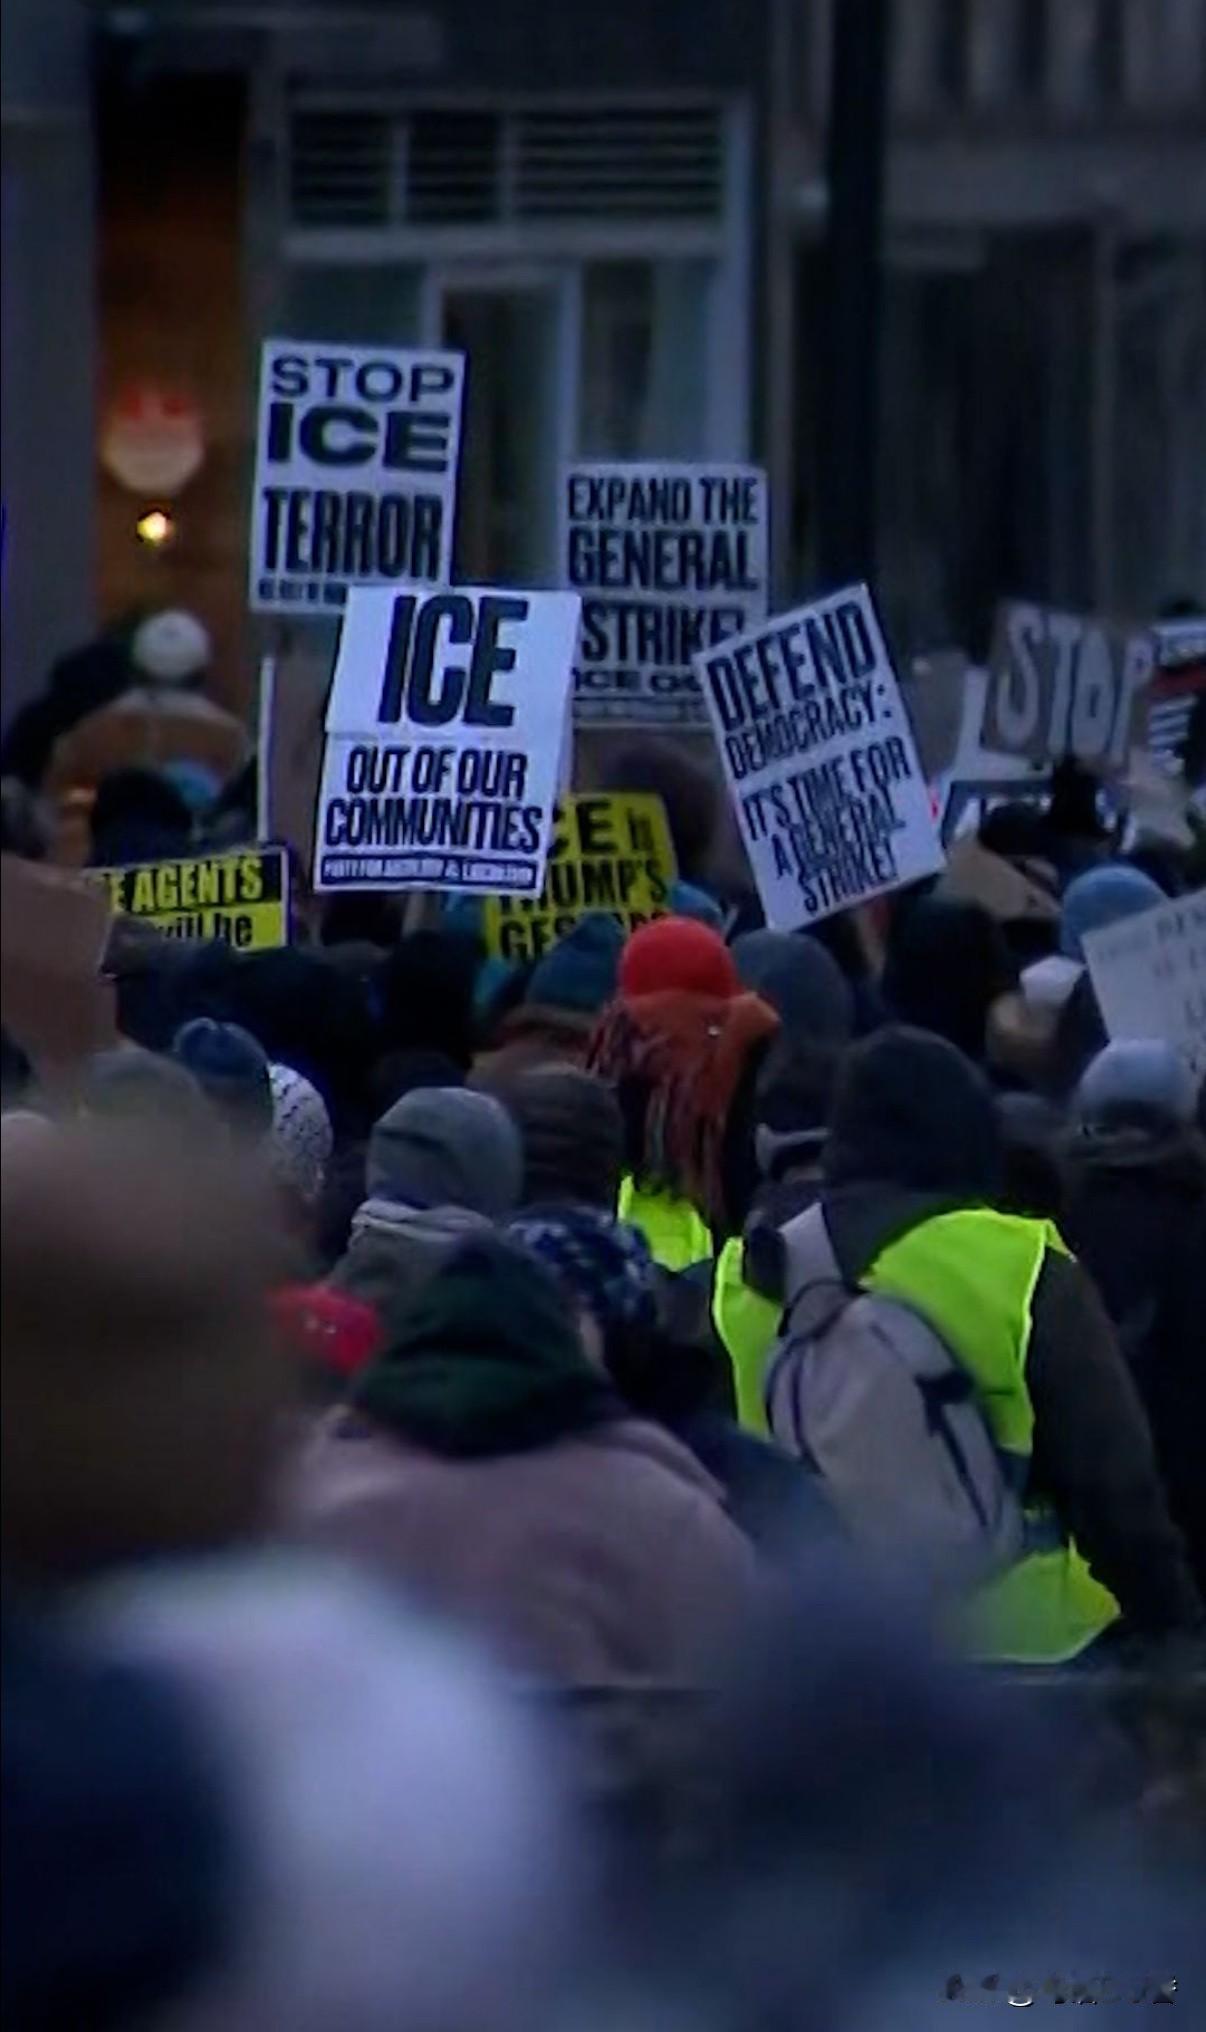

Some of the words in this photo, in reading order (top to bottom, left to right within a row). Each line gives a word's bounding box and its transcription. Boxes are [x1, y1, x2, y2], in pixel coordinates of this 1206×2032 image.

[271, 355, 455, 402] STOP
[267, 402, 452, 472] ICE
[263, 487, 443, 580] TERROR
[568, 475, 692, 524] EXPAND
[698, 477, 758, 525] THE
[568, 526, 760, 591] GENERAL
[378, 594, 529, 727] ICE
[706, 600, 877, 731] DEFEND
[995, 602, 1155, 769] STOP
[725, 680, 894, 780] DEMOCRACY:
[346, 745, 410, 794] OUT
[411, 745, 456, 794] OF
[456, 747, 528, 800] OUR
[787, 755, 846, 818] TIME
[850, 736, 912, 793] FOR
[325, 796, 543, 855] COMMUNITIES
[771, 834, 793, 879] A
[789, 786, 906, 869] GENERAL
[131, 855, 263, 914] AGENTS
